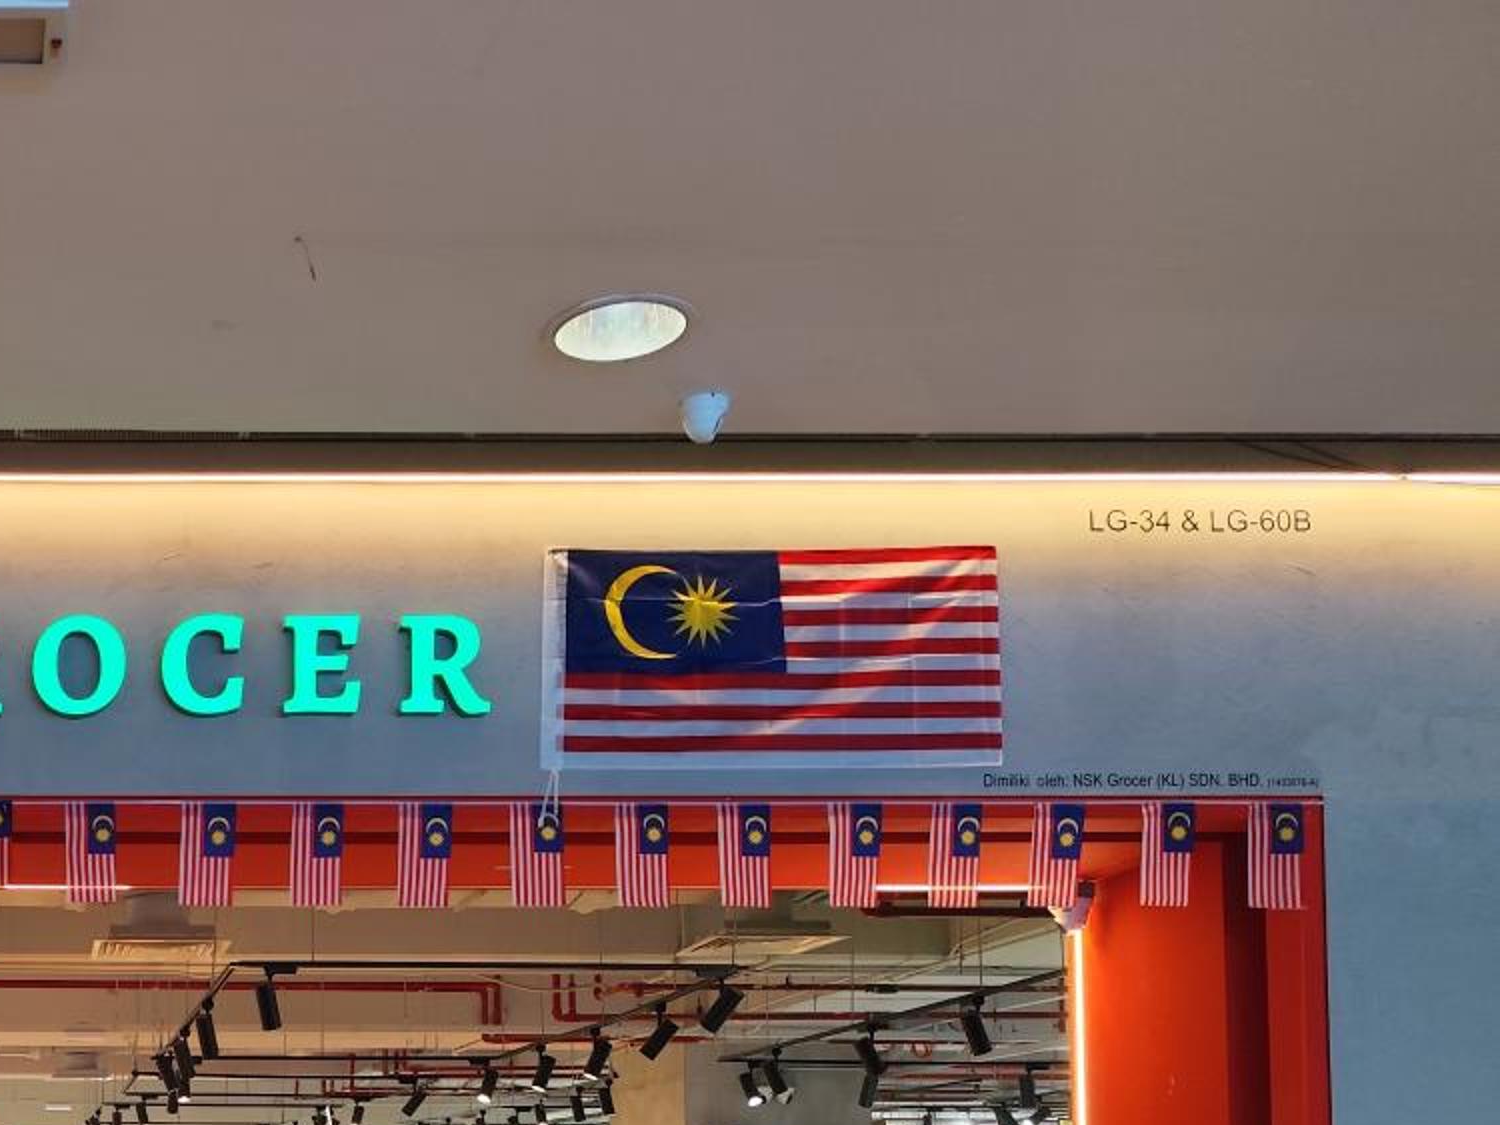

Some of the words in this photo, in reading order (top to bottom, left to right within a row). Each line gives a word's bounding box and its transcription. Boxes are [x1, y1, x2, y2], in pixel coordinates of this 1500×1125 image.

[1088, 508, 1171, 533] LG-34
[1181, 508, 1200, 533] &
[1209, 508, 1312, 533] LG-60B
[1073, 774, 1101, 788] NSK
[1107, 774, 1153, 788] Grocer
[1157, 773, 1185, 790] (KL)
